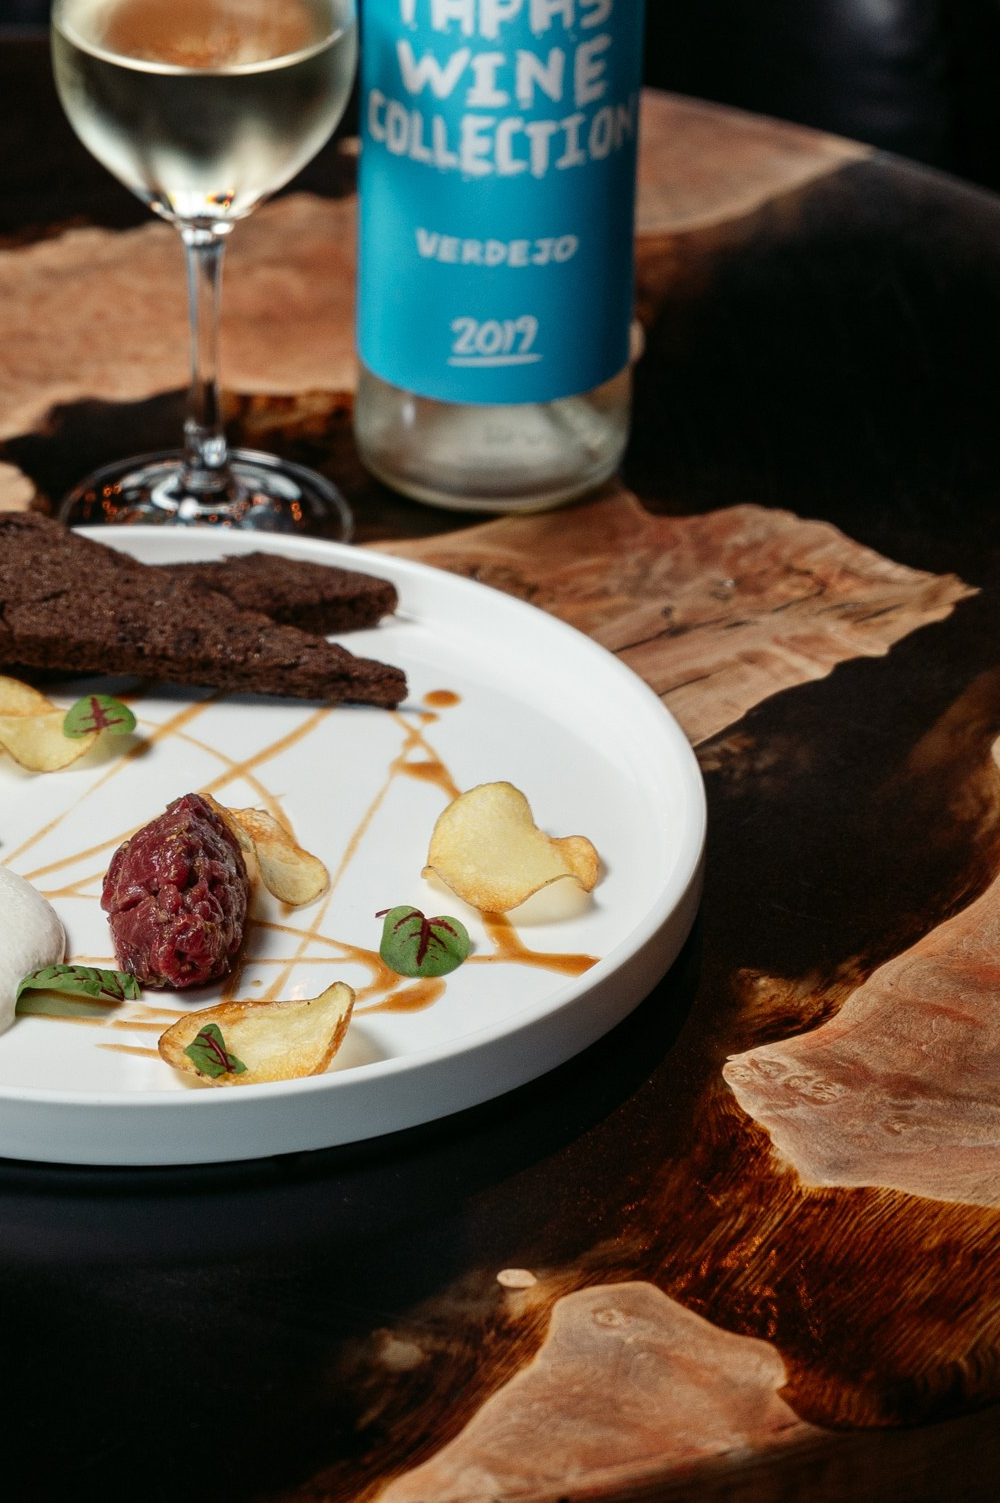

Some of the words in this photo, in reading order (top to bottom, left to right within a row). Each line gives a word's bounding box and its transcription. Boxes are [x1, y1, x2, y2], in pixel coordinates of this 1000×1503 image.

[397, 34, 611, 108] WINE
[368, 89, 638, 179] COLLECTION
[415, 226, 579, 267] VERDEJO
